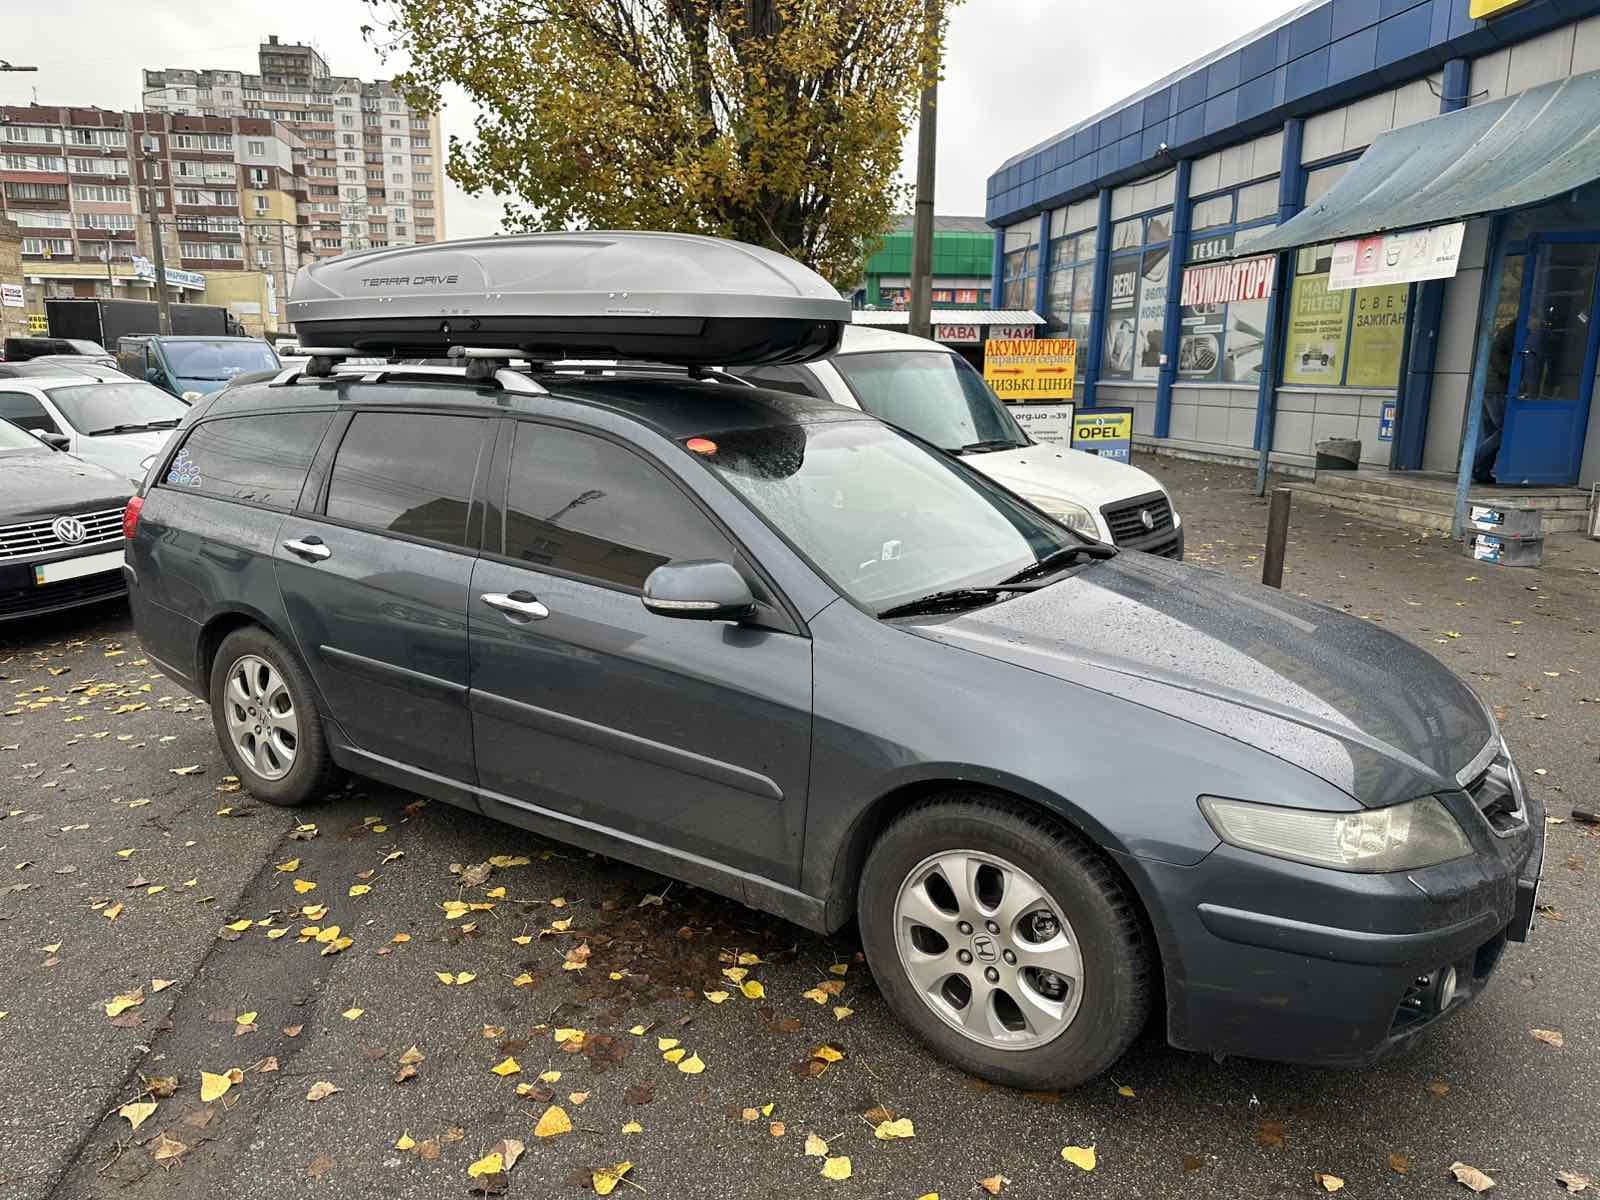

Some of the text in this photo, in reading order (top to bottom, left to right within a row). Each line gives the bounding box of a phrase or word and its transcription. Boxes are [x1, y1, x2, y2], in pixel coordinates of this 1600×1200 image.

[1192, 239, 1227, 260] TESLA
[361, 275, 458, 287] TERRA DRIVE
[1112, 271, 1136, 297] BERU
[1180, 256, 1276, 306] АКУМУЛЯТОРИ
[1301, 279, 1329, 297] MAN
[938, 326, 976, 339] КАВА
[986, 340, 1075, 356] АКУМУЛЯТОРИ
[1039, 378, 1073, 392] ЦІНИ
[1079, 427, 1121, 439] OPEL
